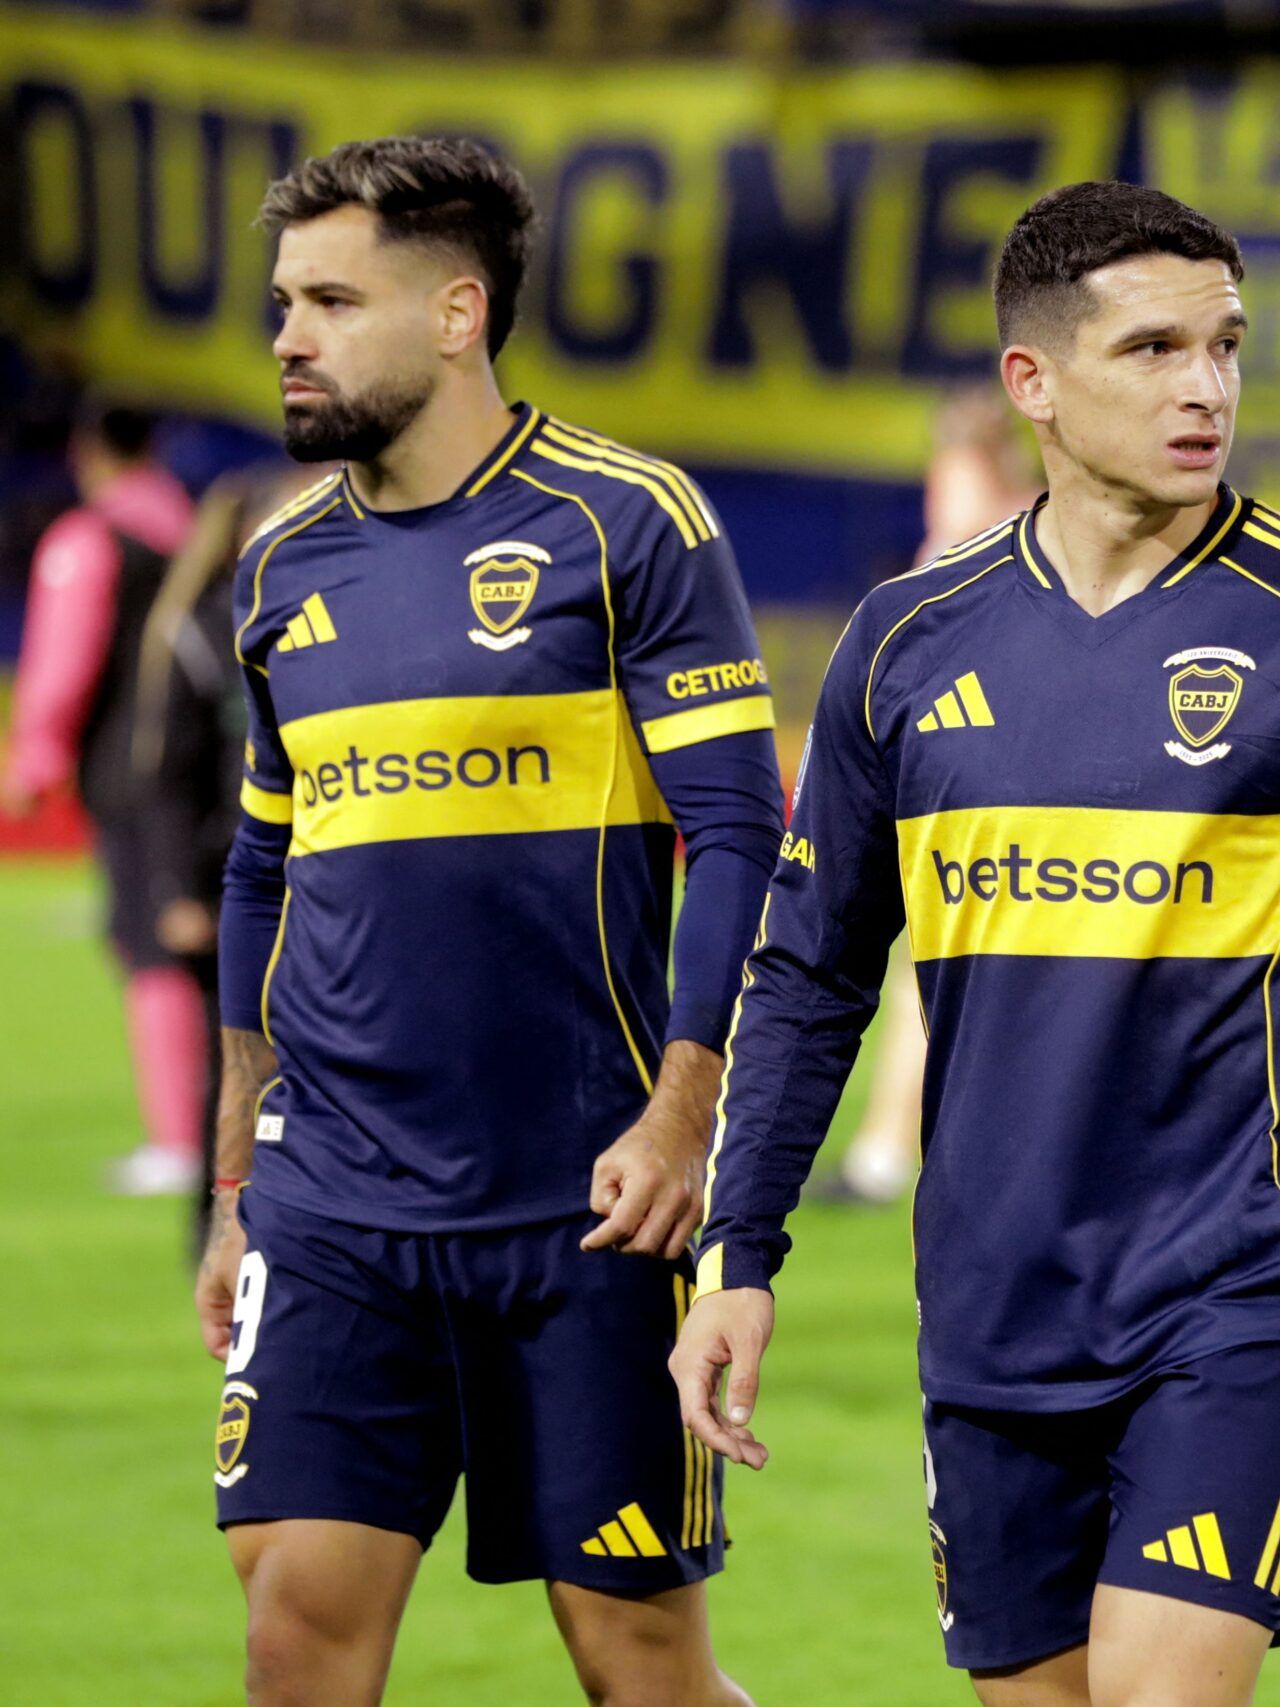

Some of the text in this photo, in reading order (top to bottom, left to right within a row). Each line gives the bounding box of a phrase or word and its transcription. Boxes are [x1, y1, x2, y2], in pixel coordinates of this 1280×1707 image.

[481, 585, 526, 599] CABJ
[1179, 693, 1229, 709] CABJ
[932, 844, 1214, 904] betsson
[225, 1250, 268, 1376] 9
